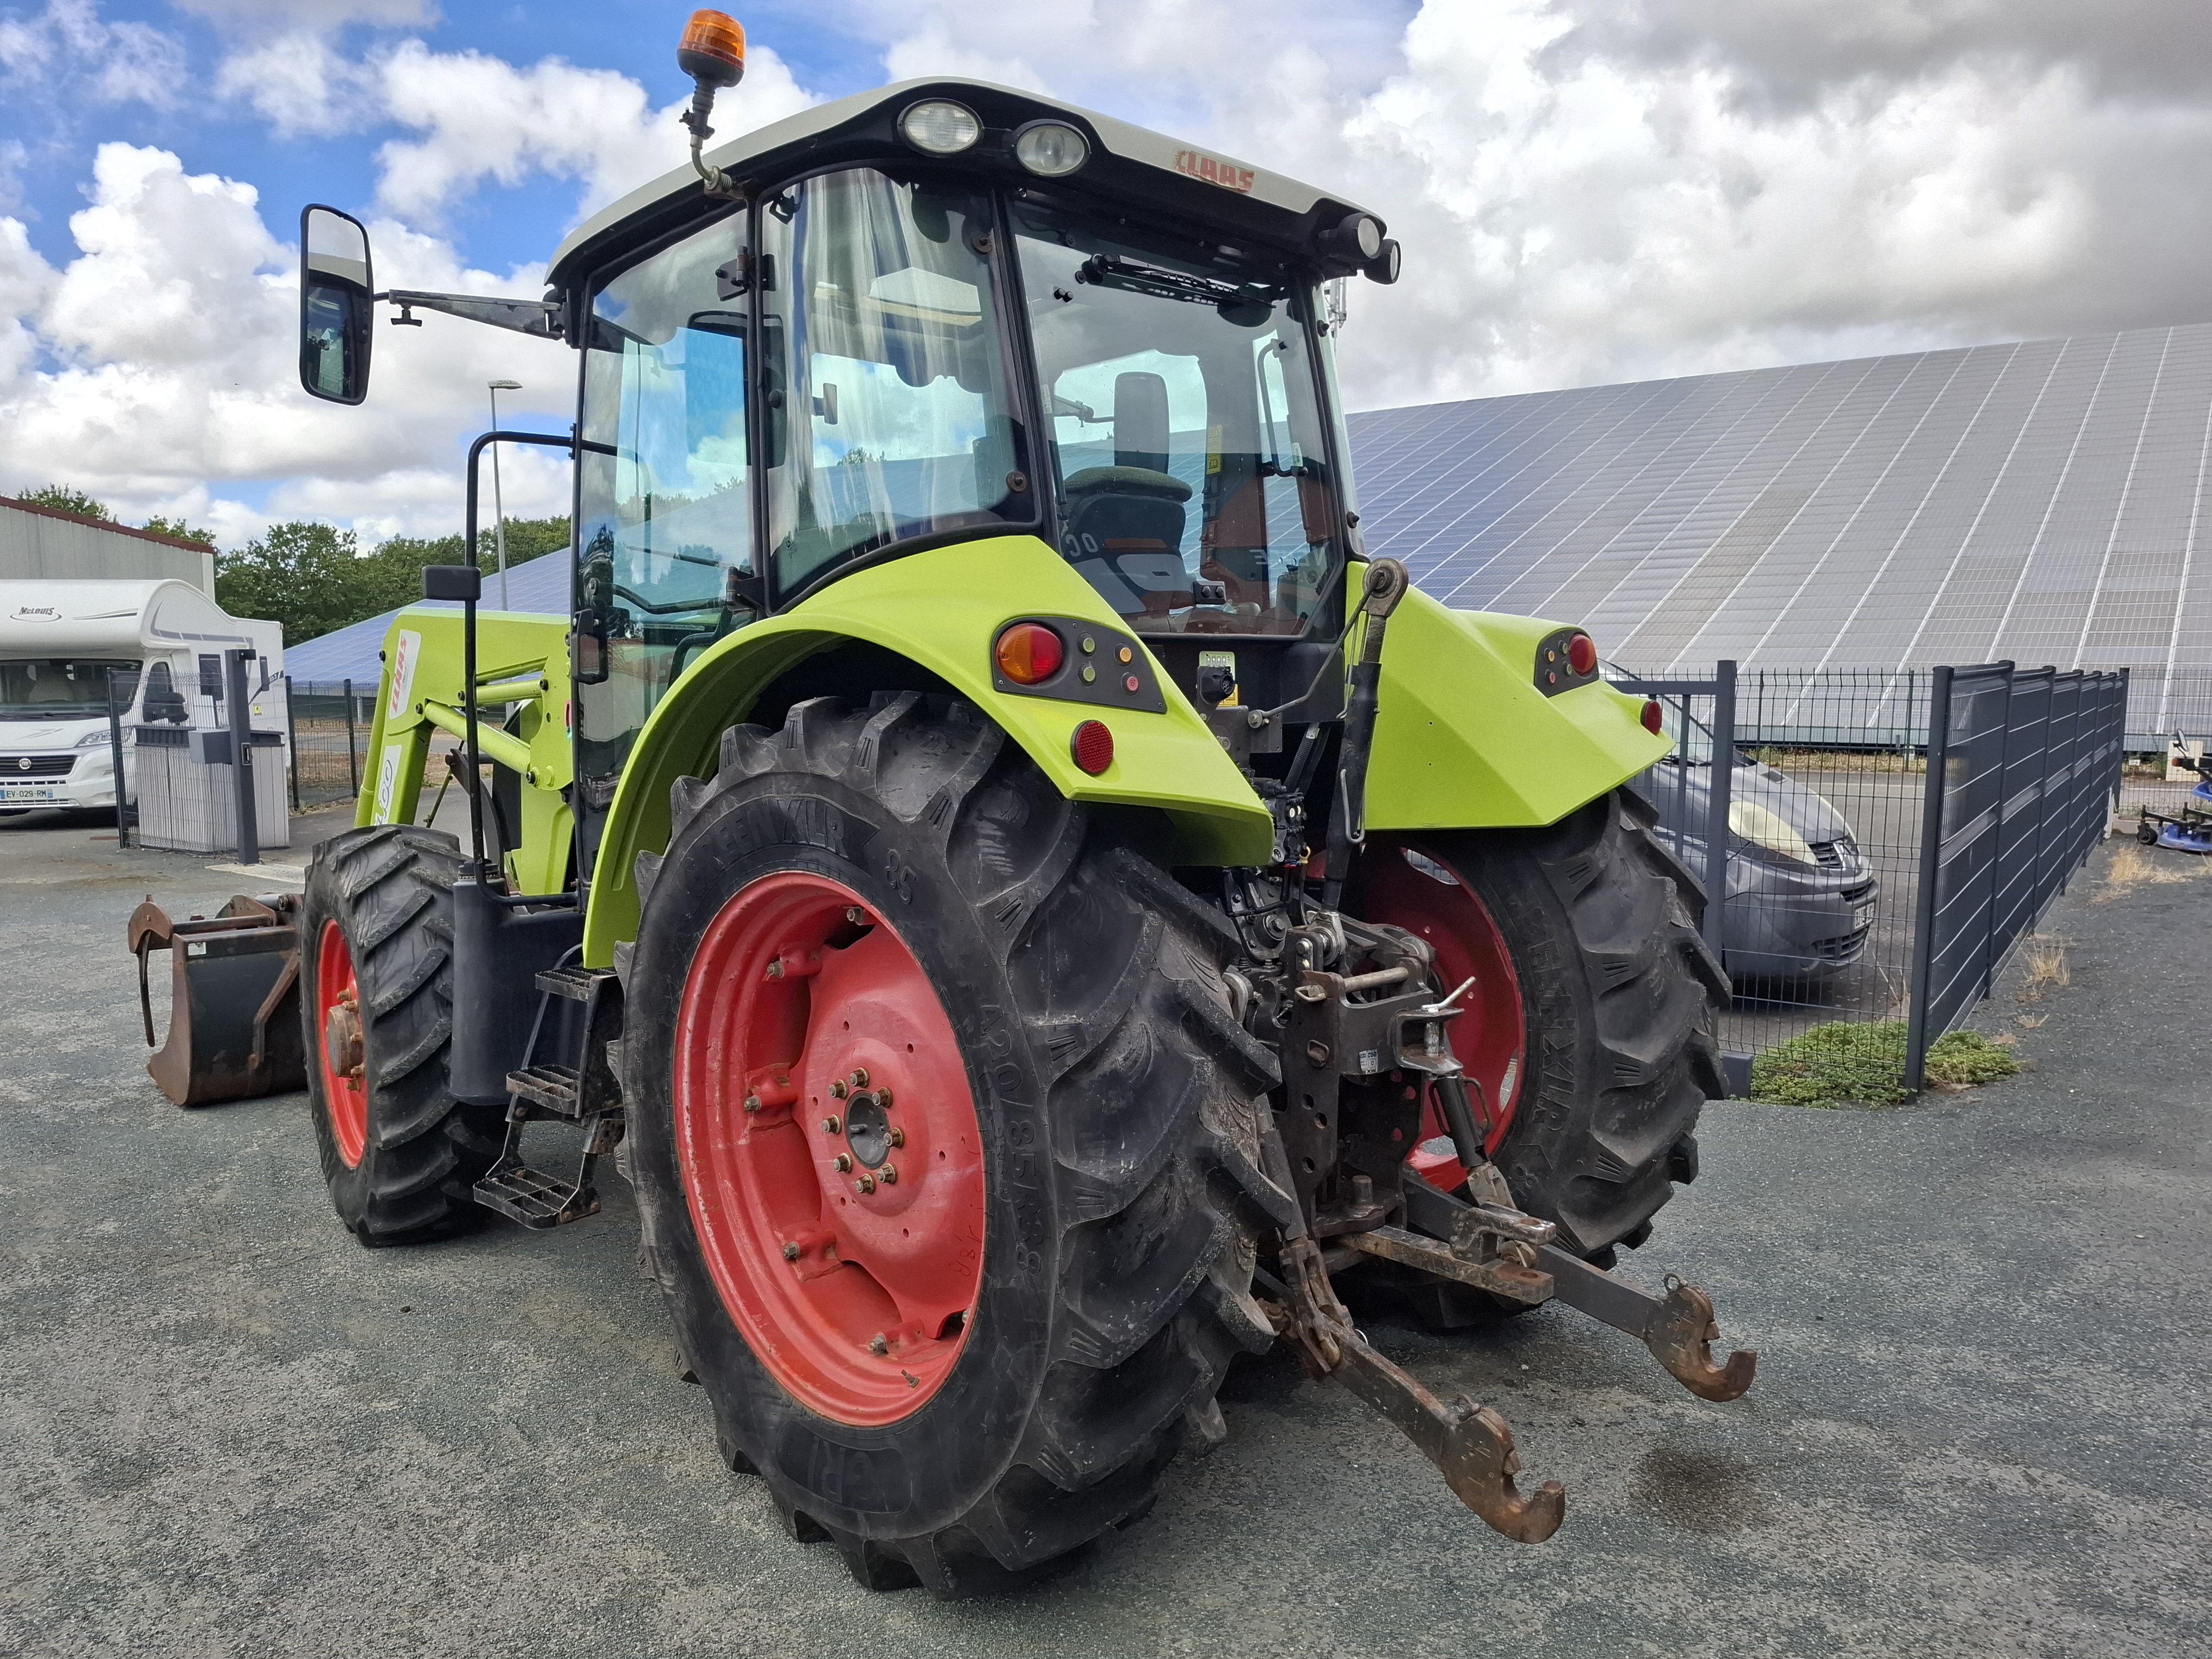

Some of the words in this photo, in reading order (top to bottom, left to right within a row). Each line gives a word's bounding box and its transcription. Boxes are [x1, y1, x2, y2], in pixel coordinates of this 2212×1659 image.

[1176, 149, 1256, 191] CLAAS
[392, 634, 407, 713] CLAAS
[6, 789, 47, 798] EV-029-RM
[776, 799, 849, 859] XLR
[885, 848, 918, 905] 85
[806, 1437, 877, 1504] GRI
